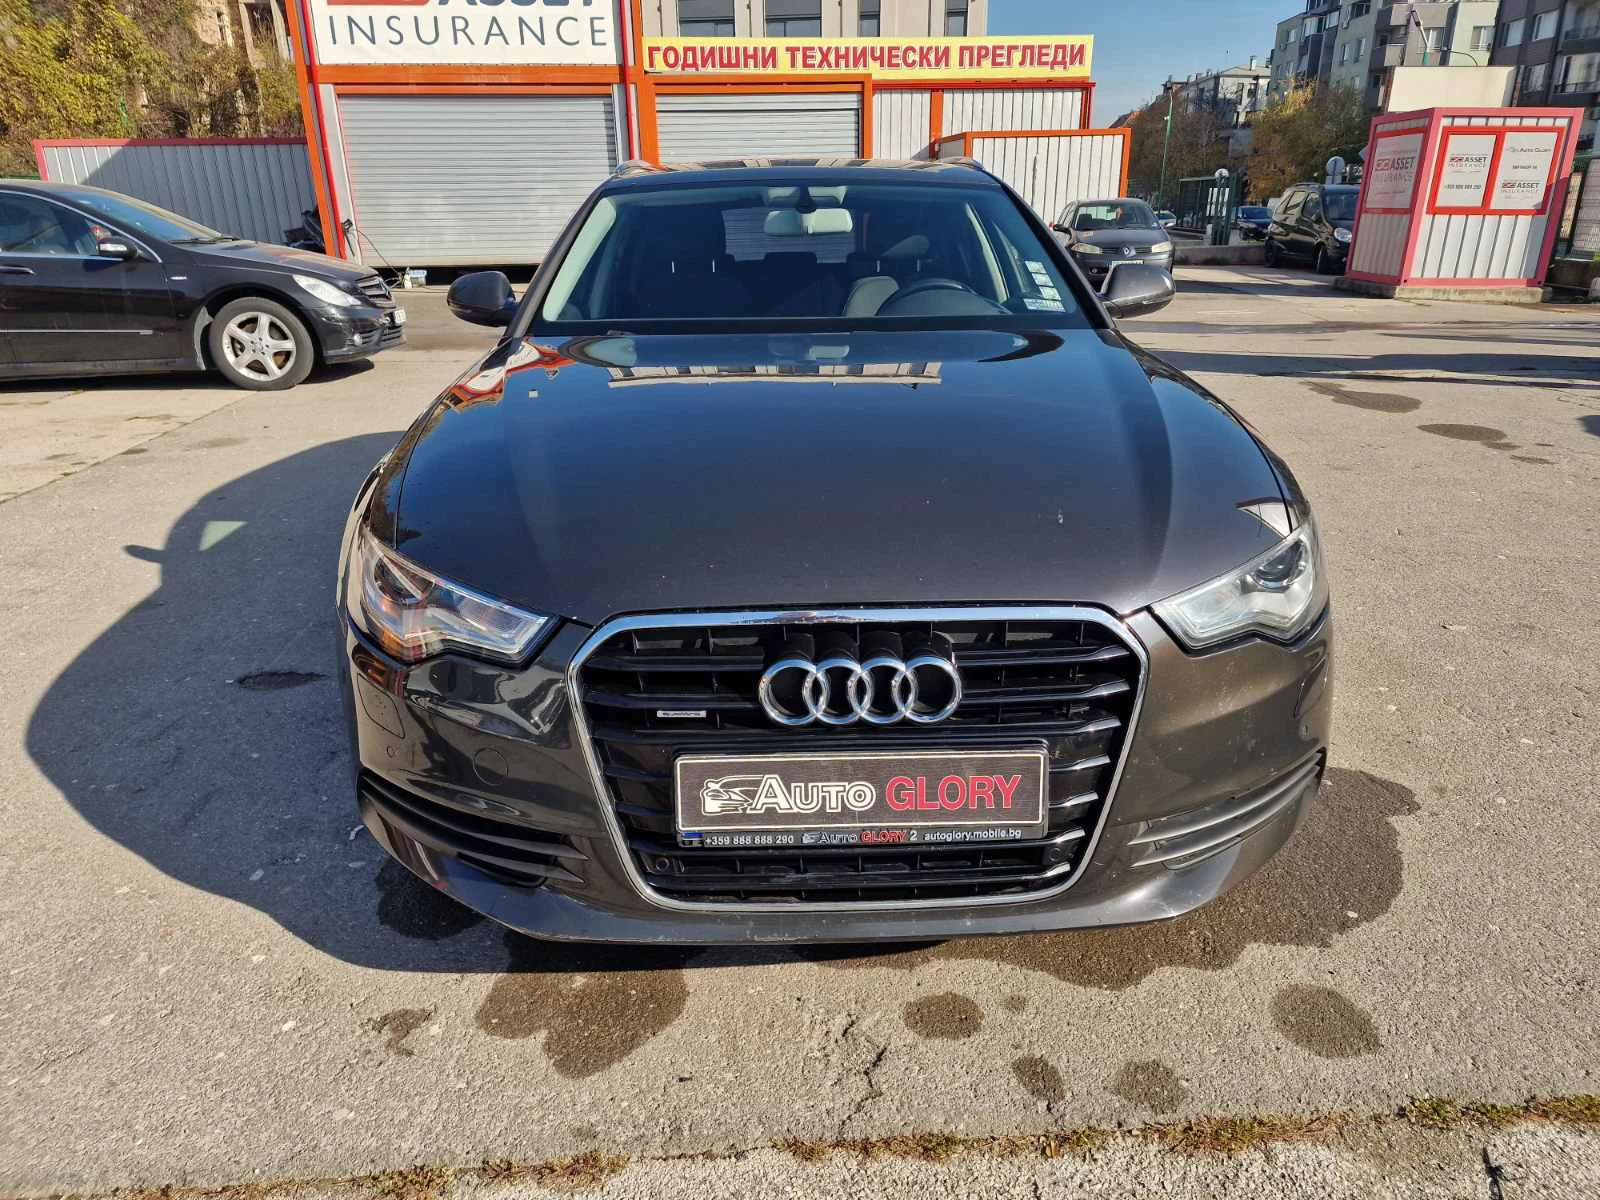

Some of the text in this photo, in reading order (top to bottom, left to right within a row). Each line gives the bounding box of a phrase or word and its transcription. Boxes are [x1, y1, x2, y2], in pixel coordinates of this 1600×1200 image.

[328, 15, 607, 46] INSURANCE
[648, 44, 1086, 71] ГОДИШНИ ТЕХНИЧЕСКИ ПРЕГЛЕДИ
[1391, 157, 1416, 169] ASSET
[886, 774, 1022, 811] GLORY
[705, 835, 730, 845] +359
[733, 835, 751, 845] 888
[754, 834, 773, 844] 888
[775, 834, 794, 844] 290
[861, 830, 907, 843] GLORY
[909, 831, 918, 841] 2
[924, 828, 1022, 842] autoglory.mobile.bg
